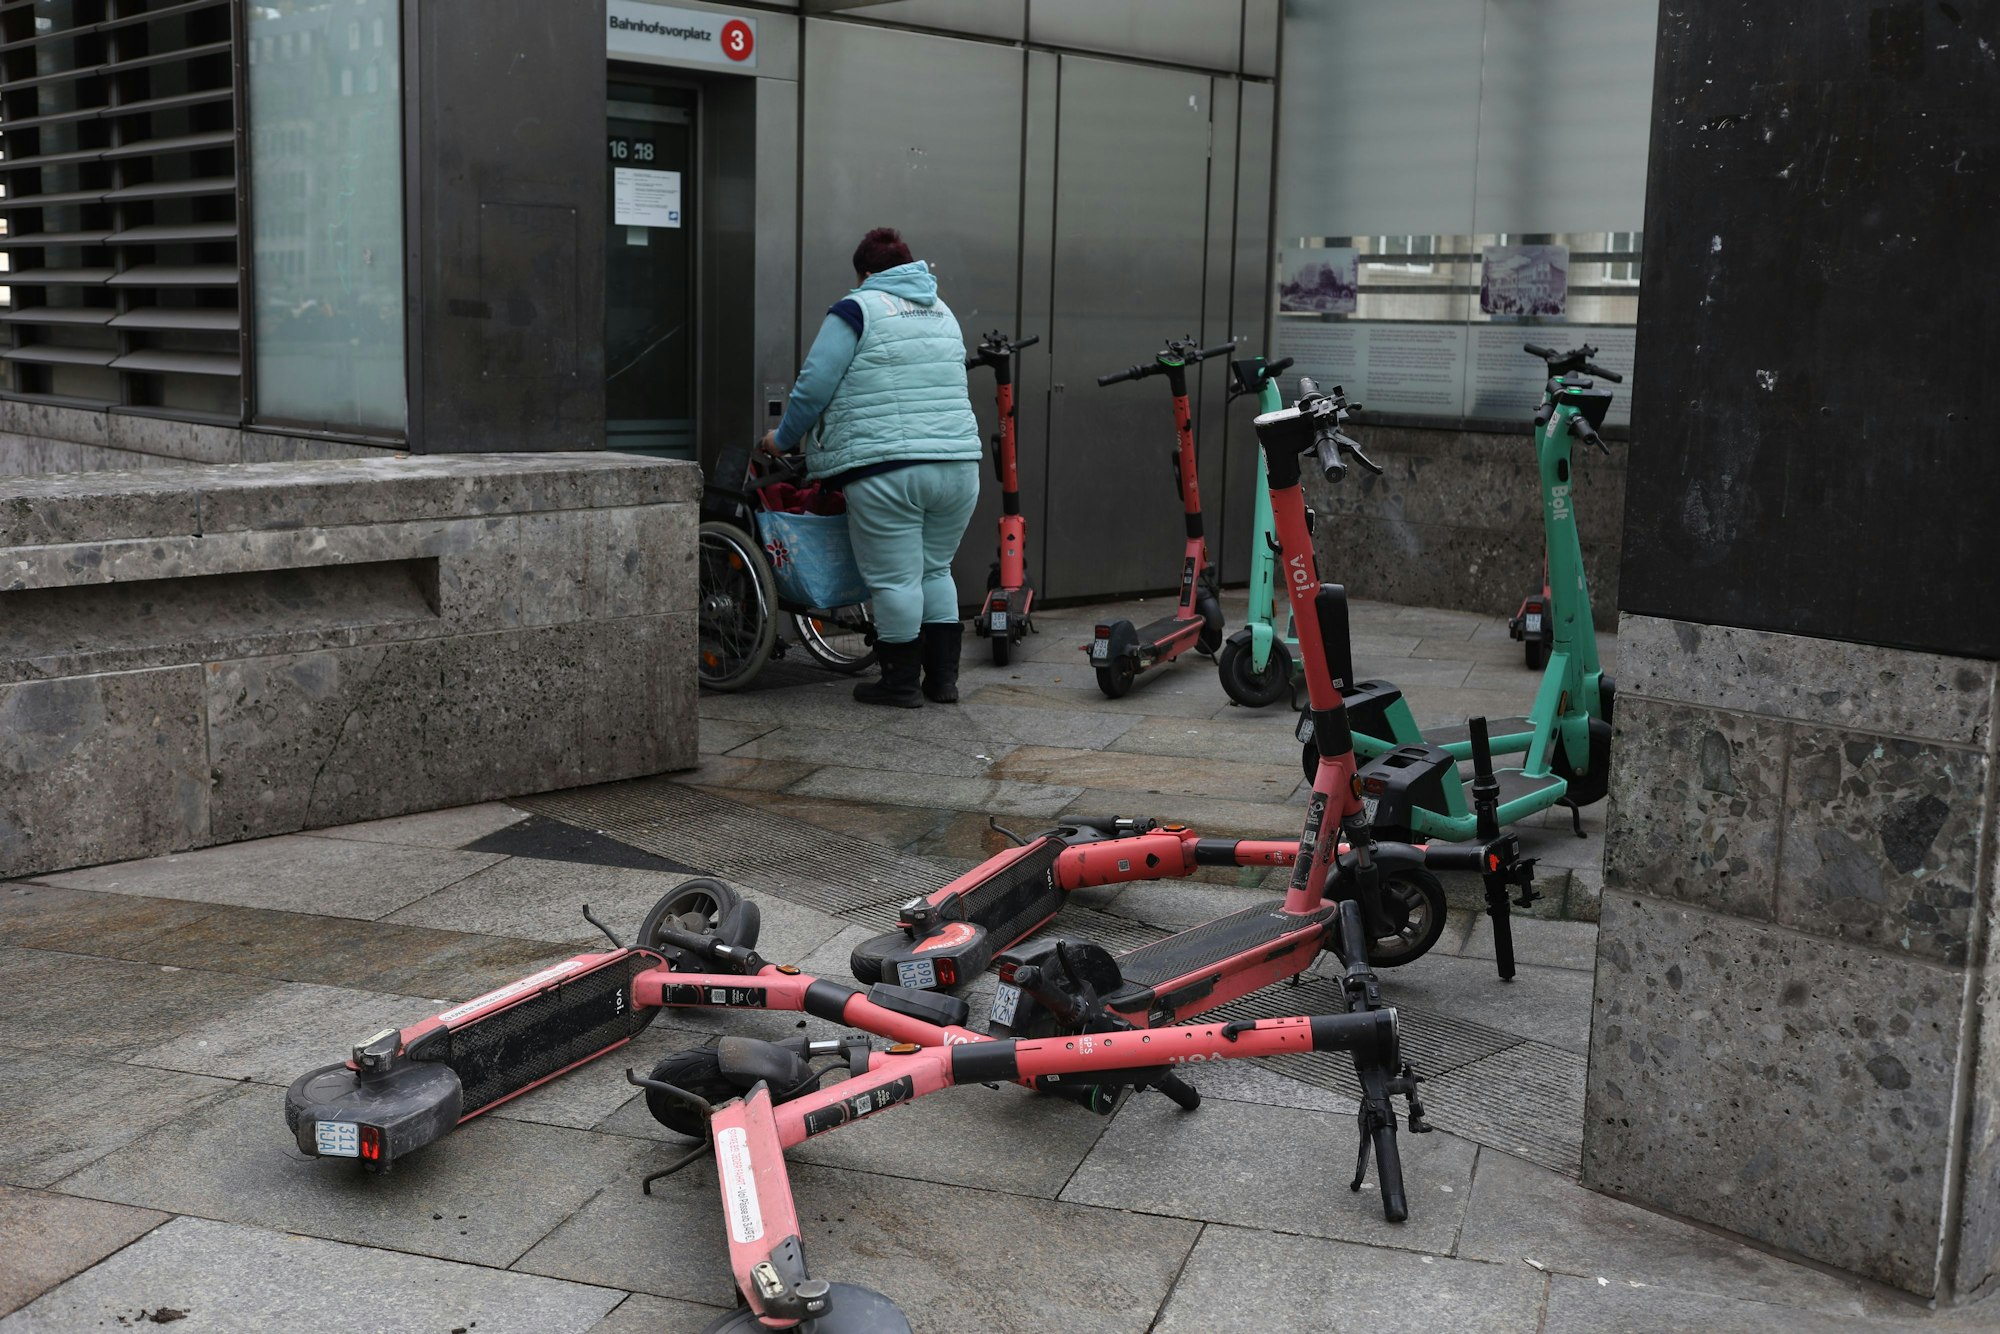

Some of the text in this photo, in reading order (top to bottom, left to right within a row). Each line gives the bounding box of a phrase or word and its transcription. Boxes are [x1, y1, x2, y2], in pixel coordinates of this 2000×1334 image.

[609, 16, 744, 51] Bahnhofsvorplatz 3
[609, 140, 628, 159] 16
[1551, 485, 1569, 521] Bolt
[900, 963, 918, 988] MJG
[917, 962, 933, 984] 898
[998, 986, 1017, 1006] 961
[992, 1003, 1014, 1026] KZN
[1083, 1036, 1093, 1054] GPS
[319, 1123, 336, 1151] MJA
[338, 1126, 356, 1151] 311
